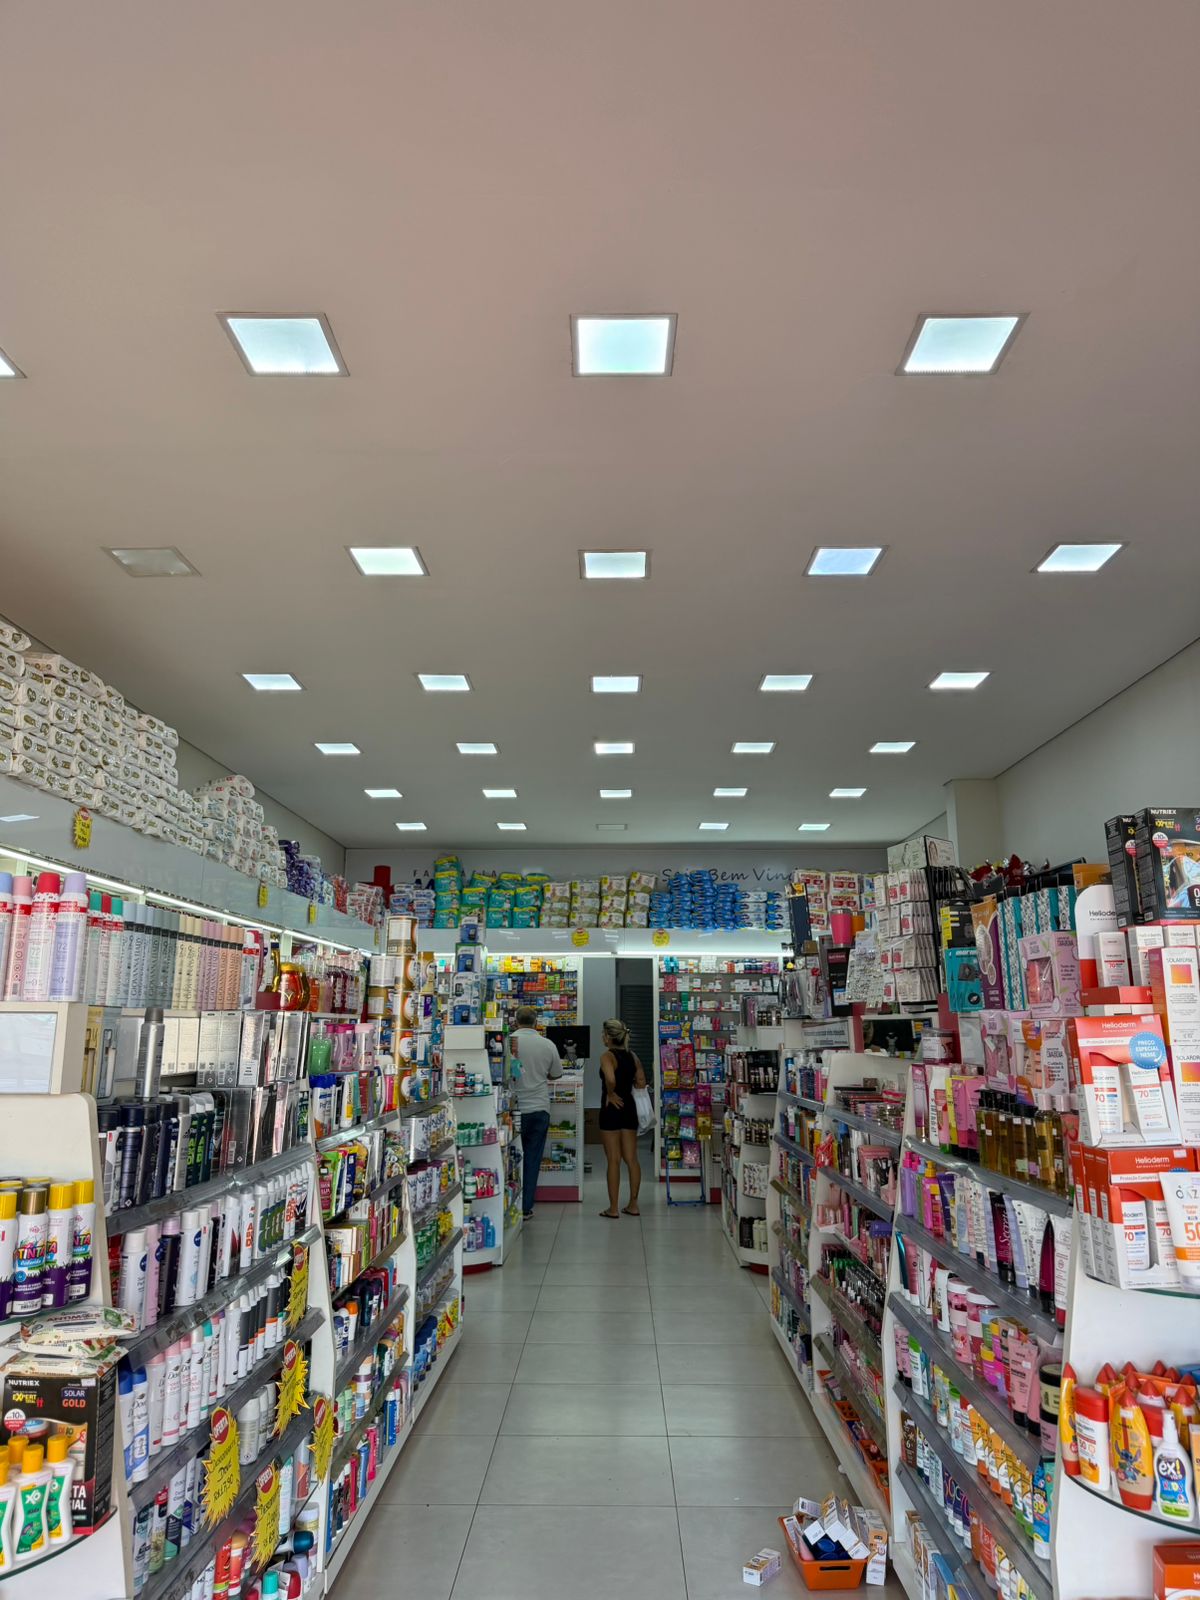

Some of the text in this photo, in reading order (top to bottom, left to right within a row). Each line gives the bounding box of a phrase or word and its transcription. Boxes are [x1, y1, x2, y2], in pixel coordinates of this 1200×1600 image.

[708, 868, 750, 882] Bem
[1094, 1093, 1105, 1103] 70
[1139, 1090, 1149, 1098] 70
[1135, 1156, 1169, 1164] Helioderm
[1161, 1228, 1172, 1236] 70
[8, 1379, 40, 1387] NUTRIEX
[62, 1399, 86, 1408] GOLD
